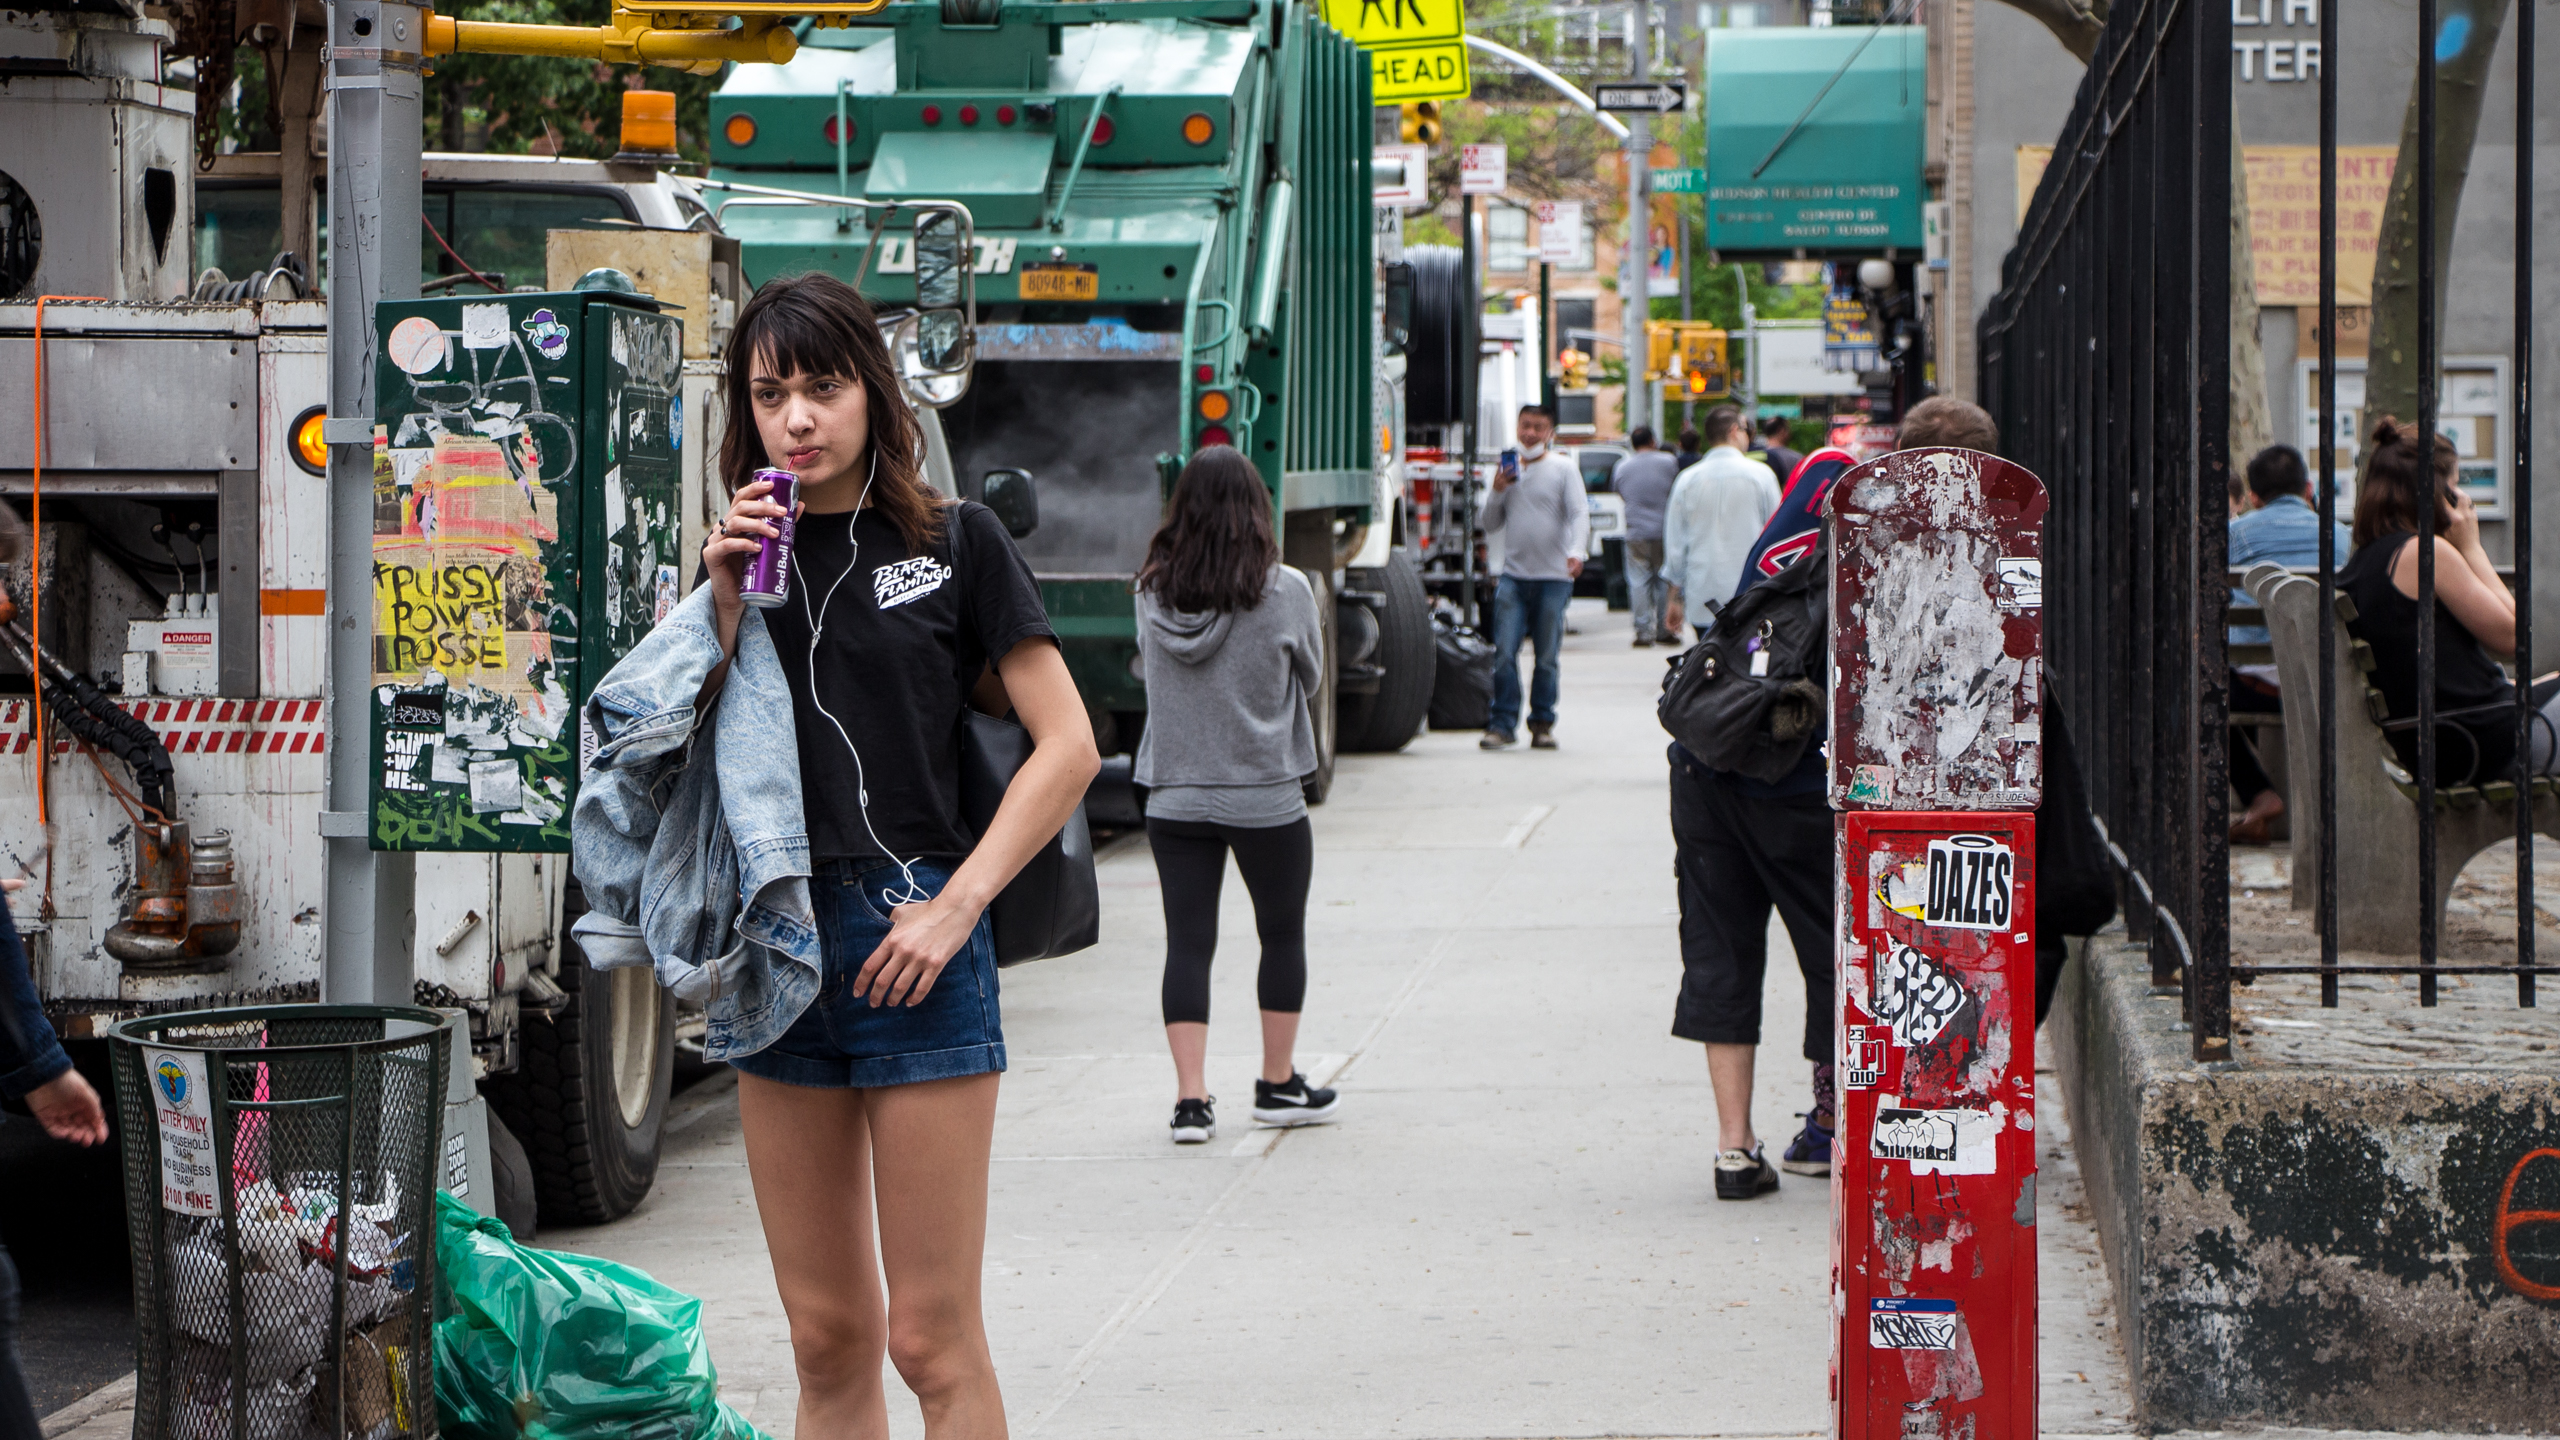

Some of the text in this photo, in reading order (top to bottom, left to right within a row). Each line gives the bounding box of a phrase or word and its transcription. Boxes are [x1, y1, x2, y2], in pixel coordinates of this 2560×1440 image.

[1609, 92, 1674, 107] ONE WAY
[1654, 173, 1692, 190] MOTT
[1836, 186, 1900, 198] CENTER
[775, 544, 789, 595] Red Bull
[872, 556, 941, 589] BLACK
[392, 562, 509, 605] PUSSY
[874, 565, 952, 606] FLAMINGO
[172, 634, 210, 643] DANGER
[393, 632, 503, 671] POSSE
[1927, 849, 2011, 926] DAZES
[159, 1108, 207, 1133] LITTER ONLY
[161, 1130, 210, 1151] NO HOUSEHOLD
[173, 1145, 193, 1159] TRASH
[447, 1133, 465, 1156] ROOM
[163, 1157, 211, 1177] NO BUSINESS
[448, 1148, 466, 1172] ZOOM
[174, 1172, 194, 1187] TRASH
[455, 1165, 467, 1185] NYC
[164, 1184, 213, 1210] $100 FINE
